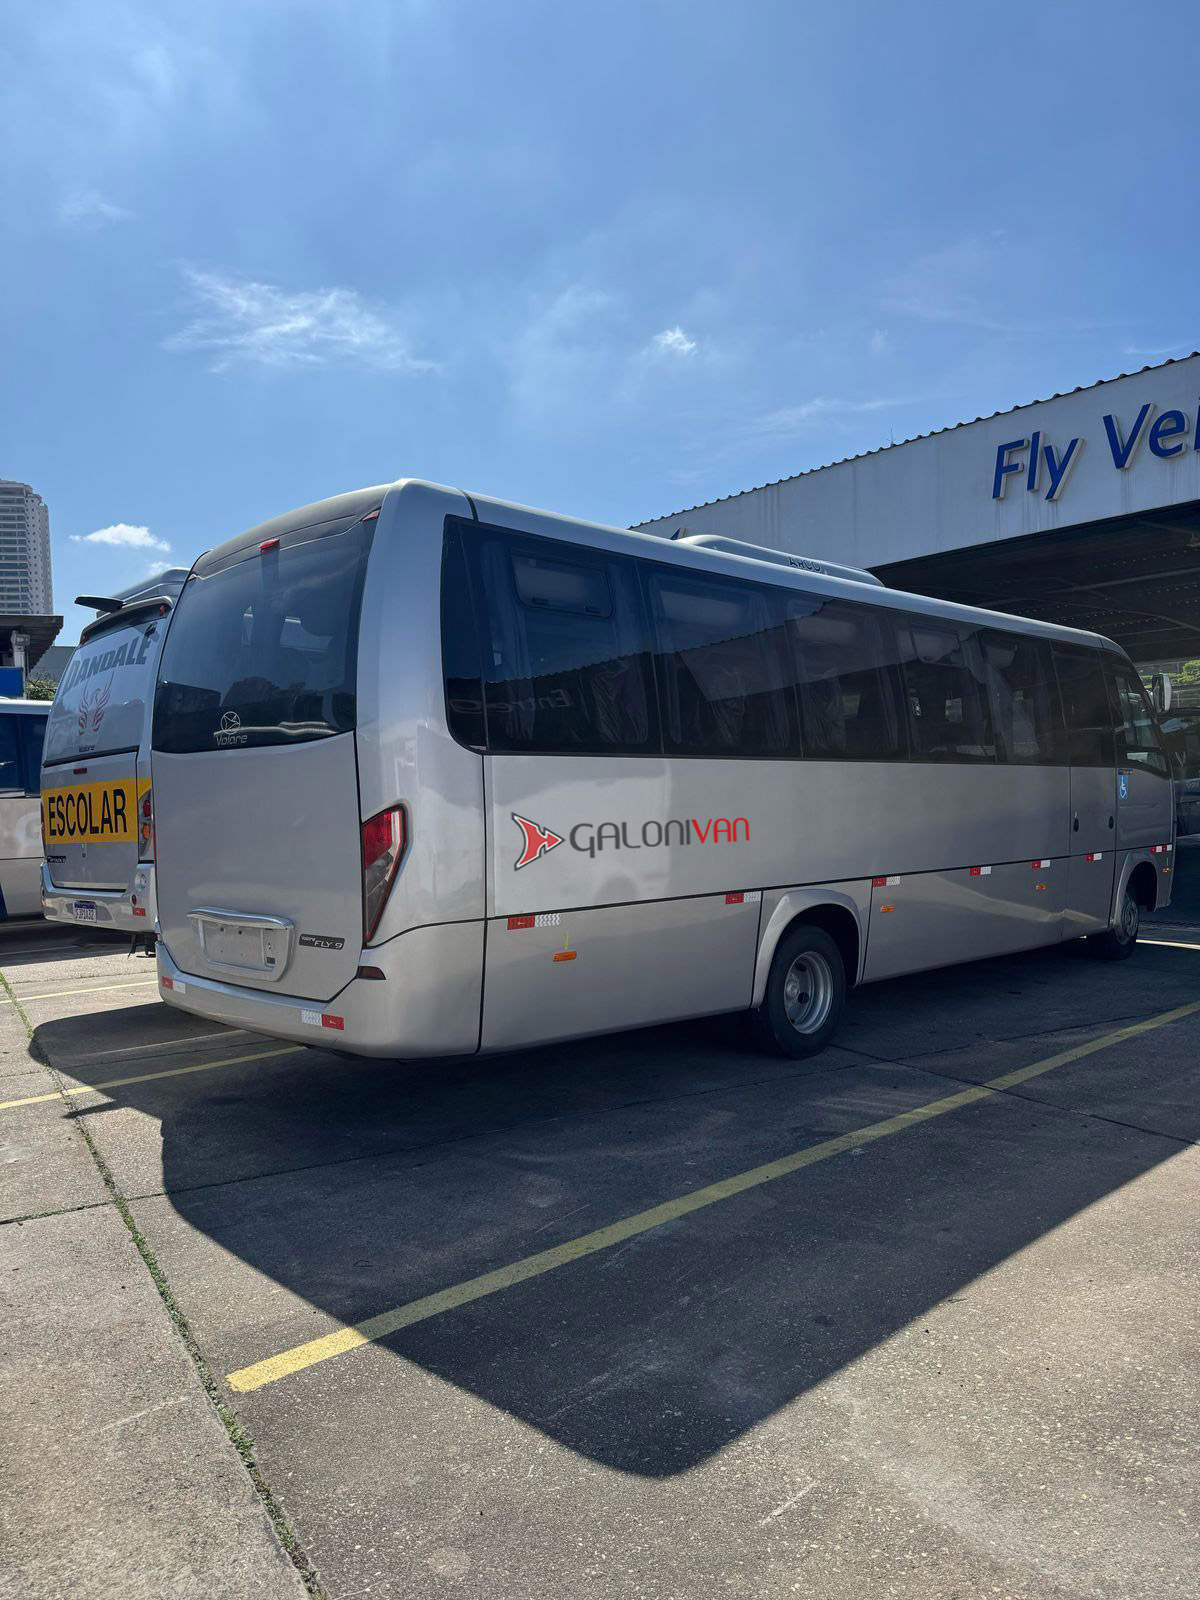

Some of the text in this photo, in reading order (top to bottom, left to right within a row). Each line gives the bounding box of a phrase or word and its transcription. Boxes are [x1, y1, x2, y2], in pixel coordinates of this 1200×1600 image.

[992, 430, 1083, 501] Fly
[215, 734, 248, 746] Volare
[48, 788, 127, 836] ESCOLAR
[314, 940, 333, 948] FLY
